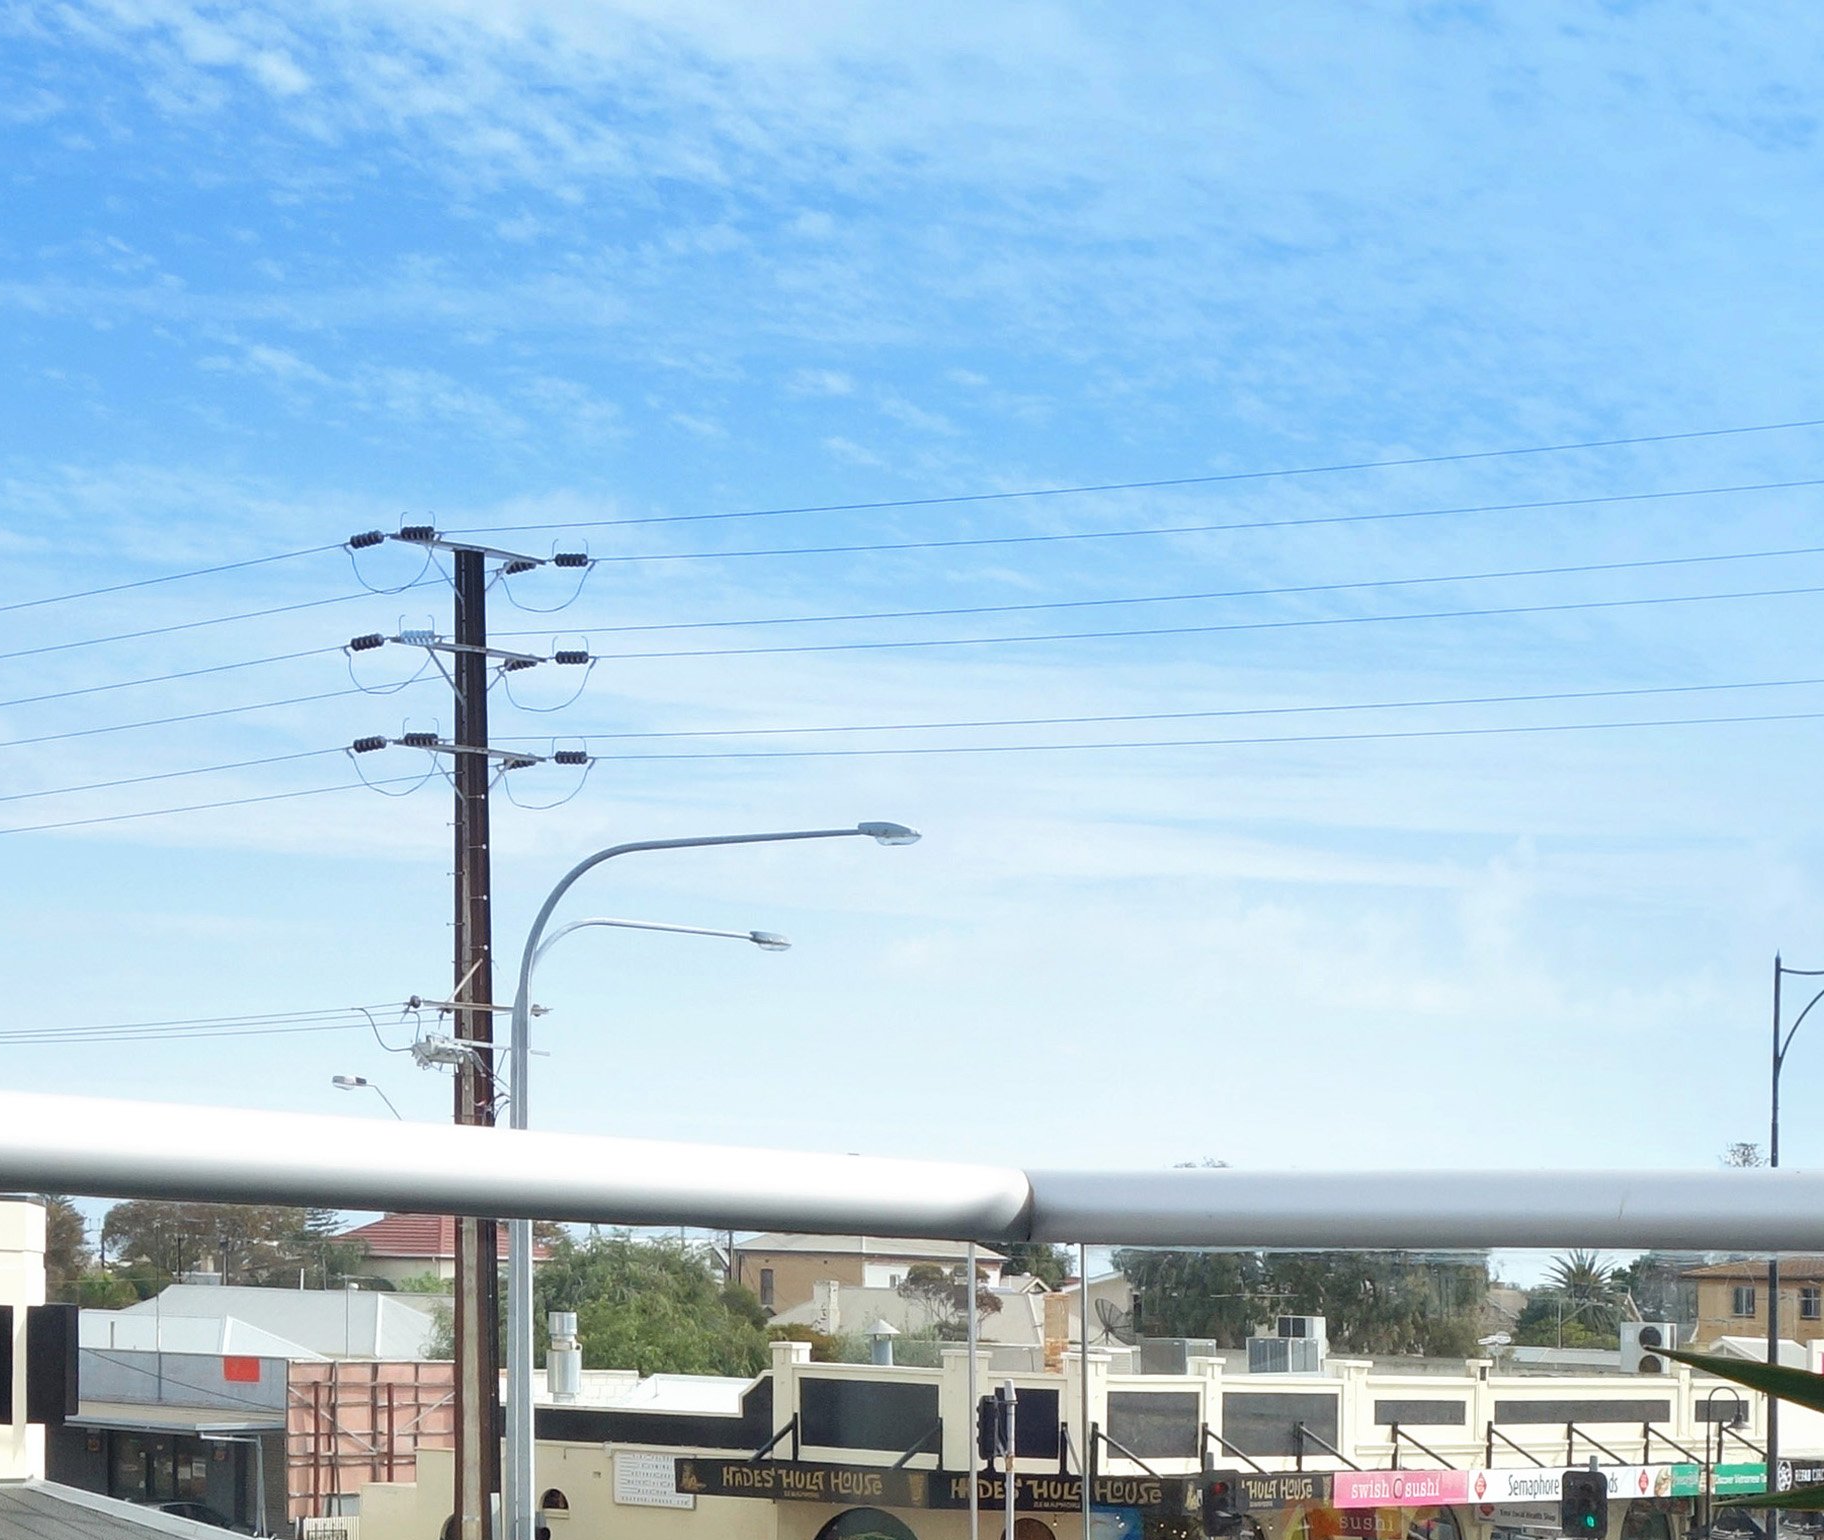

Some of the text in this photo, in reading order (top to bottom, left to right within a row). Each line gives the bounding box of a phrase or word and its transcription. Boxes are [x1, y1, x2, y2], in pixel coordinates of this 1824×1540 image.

[1351, 1477, 1440, 1499] swish sushi
[1508, 1474, 1560, 1499] Semaphore
[1339, 1511, 1395, 1532] sushi
